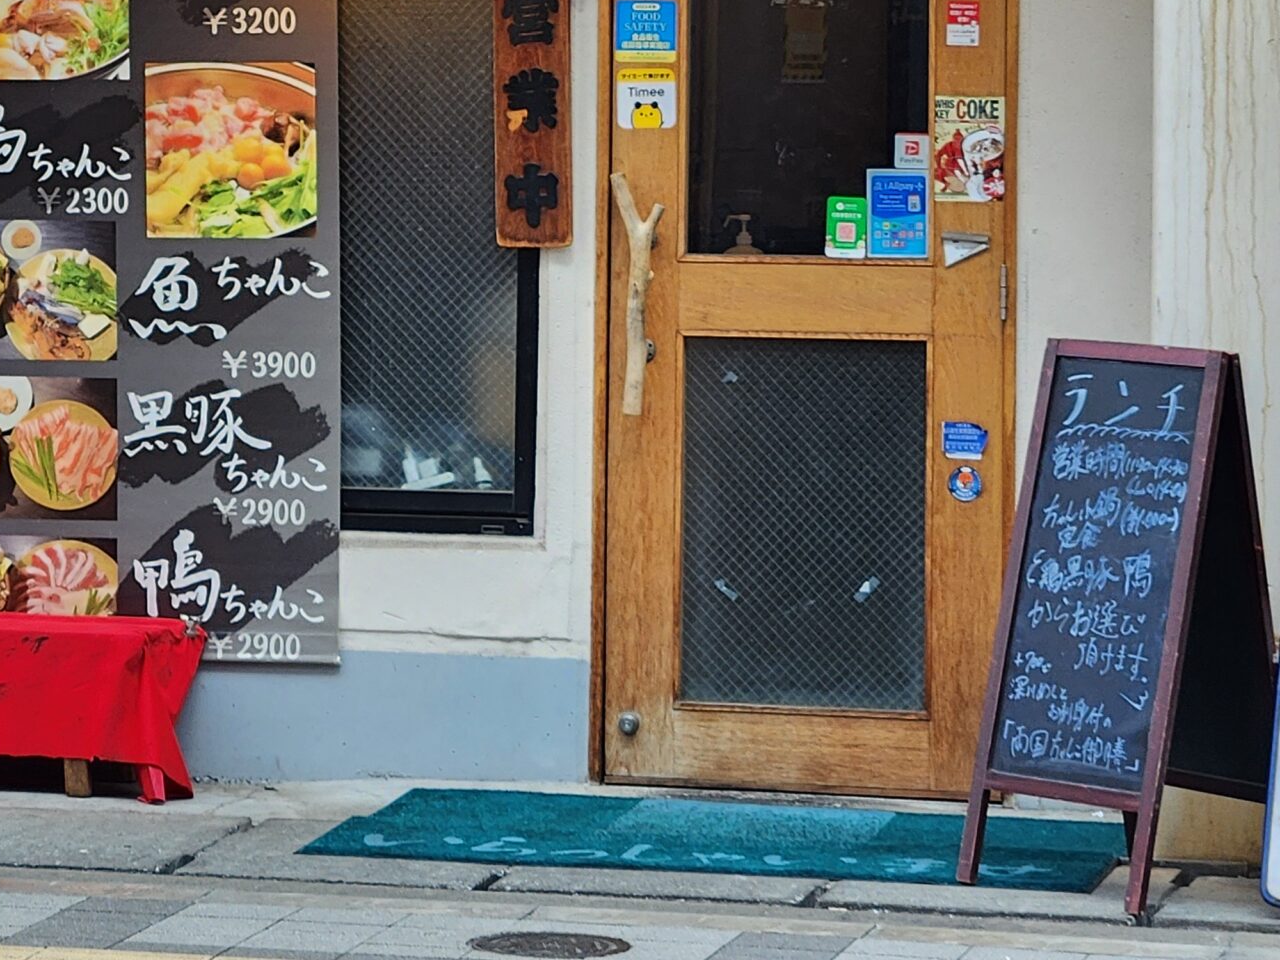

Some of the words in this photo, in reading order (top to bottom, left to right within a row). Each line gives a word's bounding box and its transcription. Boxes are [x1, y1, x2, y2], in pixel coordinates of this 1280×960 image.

[202, 6, 296, 35] ¥3200
[624, 22, 667, 31] SAFETY
[632, 12, 660, 21] FOOD
[627, 87, 665, 98] Timee
[957, 99, 999, 119] COKE
[37, 187, 129, 215] ¥2300
[222, 350, 316, 378] ¥3900
[1063, 374, 1186, 433] ランチ
[123, 388, 272, 457] 黒豚
[222, 454, 328, 493] ちゃんこ
[213, 497, 306, 526] ¥2900
[208, 634, 301, 660] ¥2900
